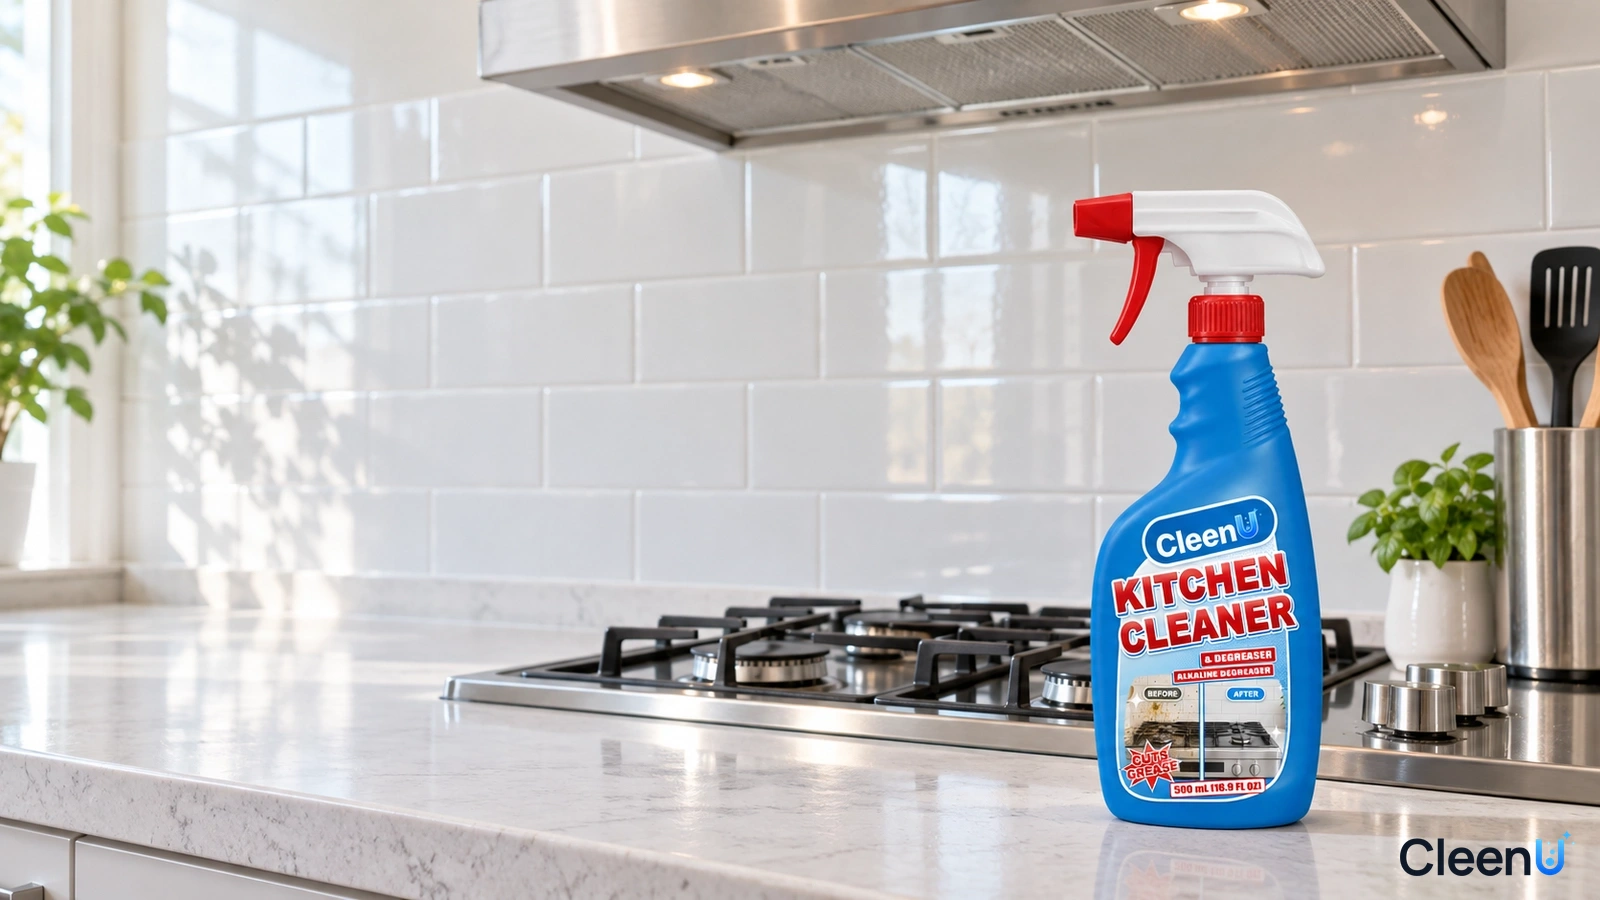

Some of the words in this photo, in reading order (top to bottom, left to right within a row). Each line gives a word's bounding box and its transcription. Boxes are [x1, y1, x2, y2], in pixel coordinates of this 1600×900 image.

[1113, 553, 1288, 614] KITCHEN
[1120, 595, 1298, 654] CLEANER
[1214, 650, 1272, 663] DEGREASER
[1177, 671, 1218, 681] ALKALINE
[1147, 690, 1178, 698] BEFORE
[1233, 690, 1259, 698] AFTER
[1132, 750, 1169, 766] CUTS
[1127, 763, 1179, 779] GREASE
[1174, 785, 1193, 794] 500
[1236, 783, 1246, 791] FL
